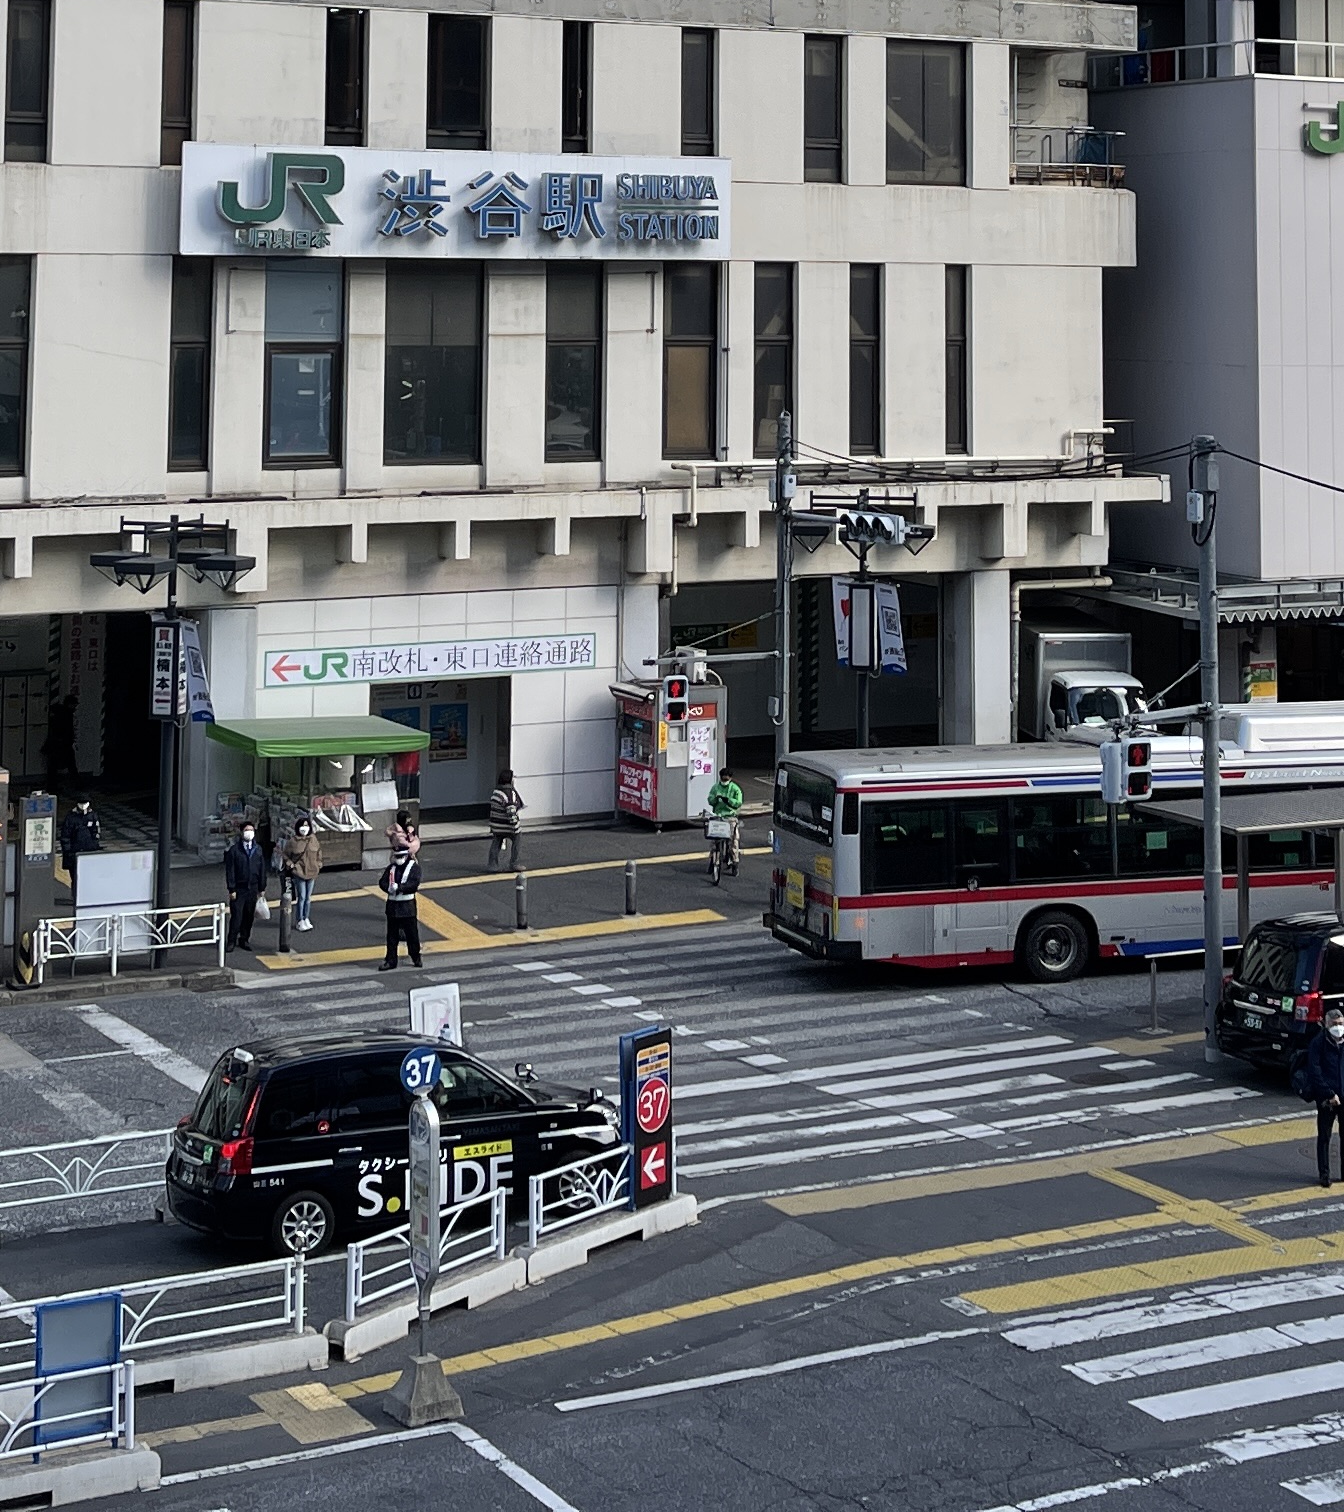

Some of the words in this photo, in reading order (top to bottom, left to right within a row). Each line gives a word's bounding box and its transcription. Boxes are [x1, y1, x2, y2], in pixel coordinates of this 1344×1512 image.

[217, 152, 345, 226] JR
[378, 168, 606, 239] 渋谷駅
[616, 172, 719, 201] SHIBUYA
[234, 228, 332, 249] JR東日本
[616, 212, 719, 240] STATION
[303, 652, 349, 680] JR
[352, 637, 592, 678] 南改札・東口連絡通路
[405, 1054, 436, 1088] 37
[640, 1086, 666, 1124] 37
[358, 1148, 448, 1175] タクシーリ
[463, 1143, 503, 1157] エスライド
[357, 1154, 514, 1218] S.IDE
